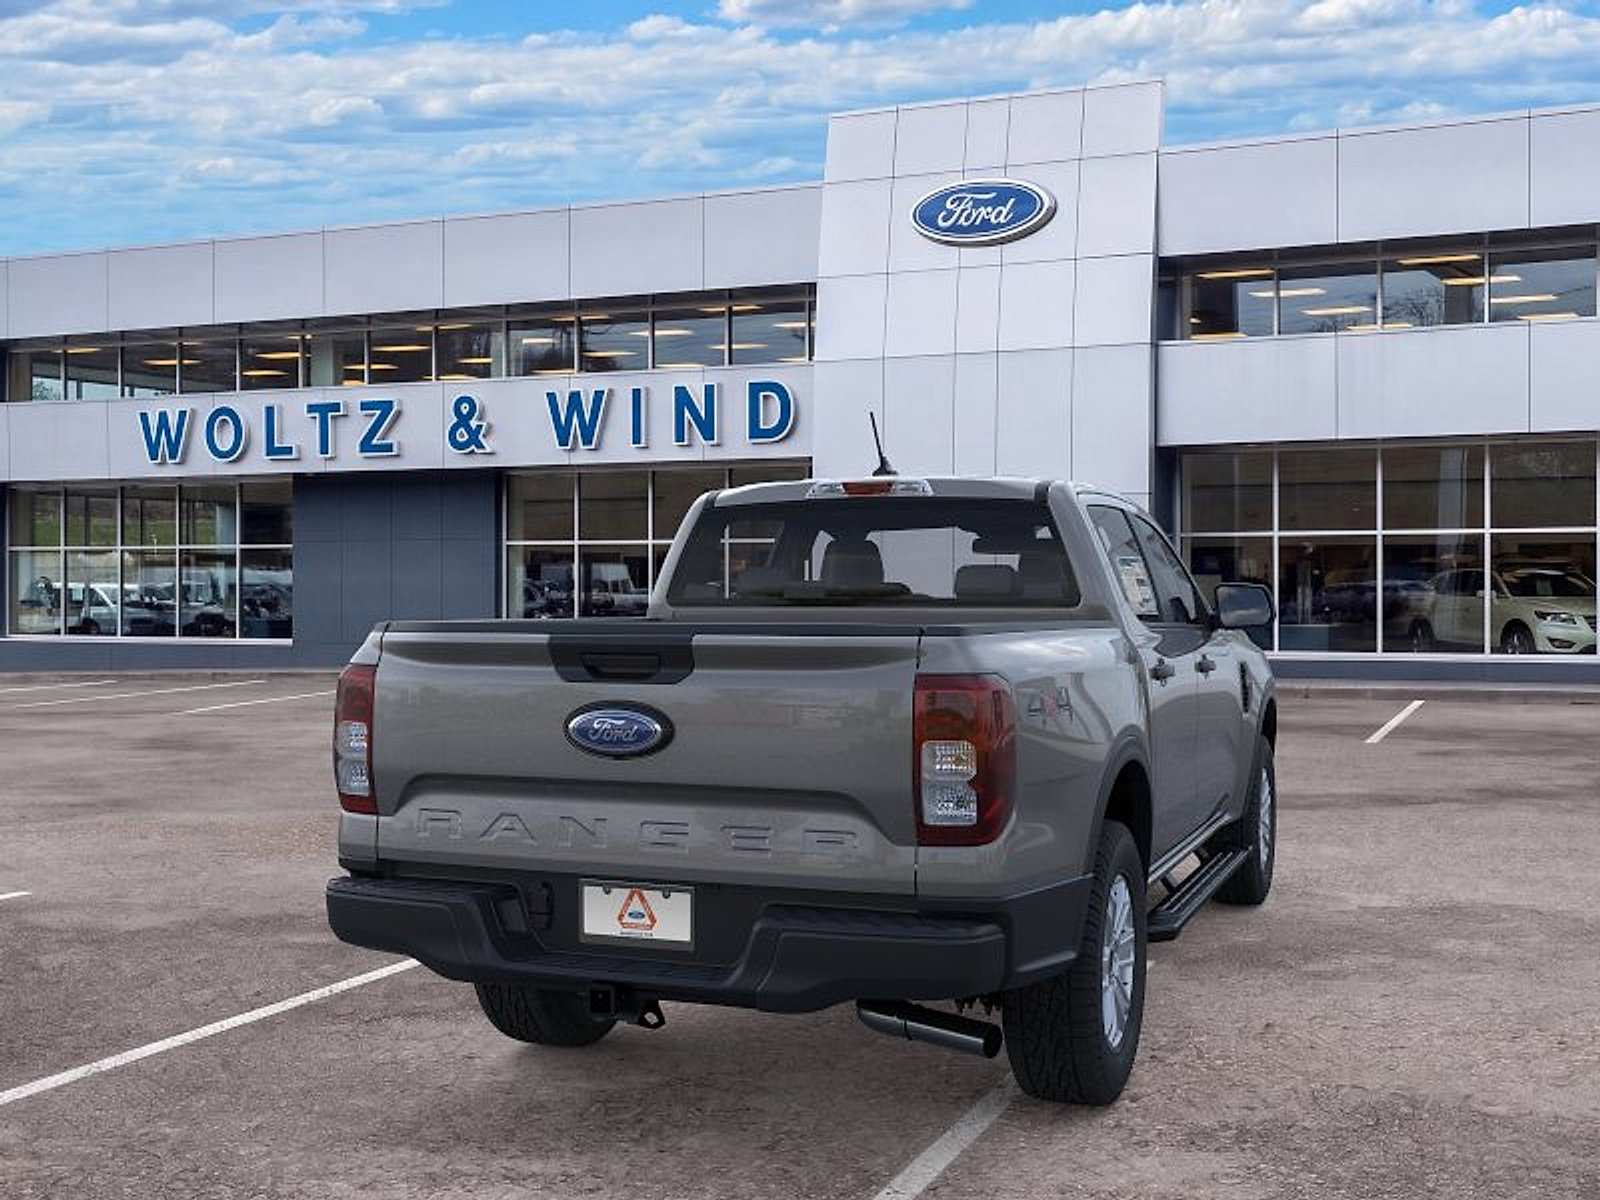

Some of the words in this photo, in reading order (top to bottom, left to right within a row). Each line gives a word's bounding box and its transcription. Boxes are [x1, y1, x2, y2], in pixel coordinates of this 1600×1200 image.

[937, 192, 1015, 227] Ford
[138, 399, 401, 464] WOLTZ
[447, 394, 493, 454] &
[545, 379, 797, 451] WIND
[588, 717, 638, 741] Ford
[417, 807, 859, 862] RANGER
